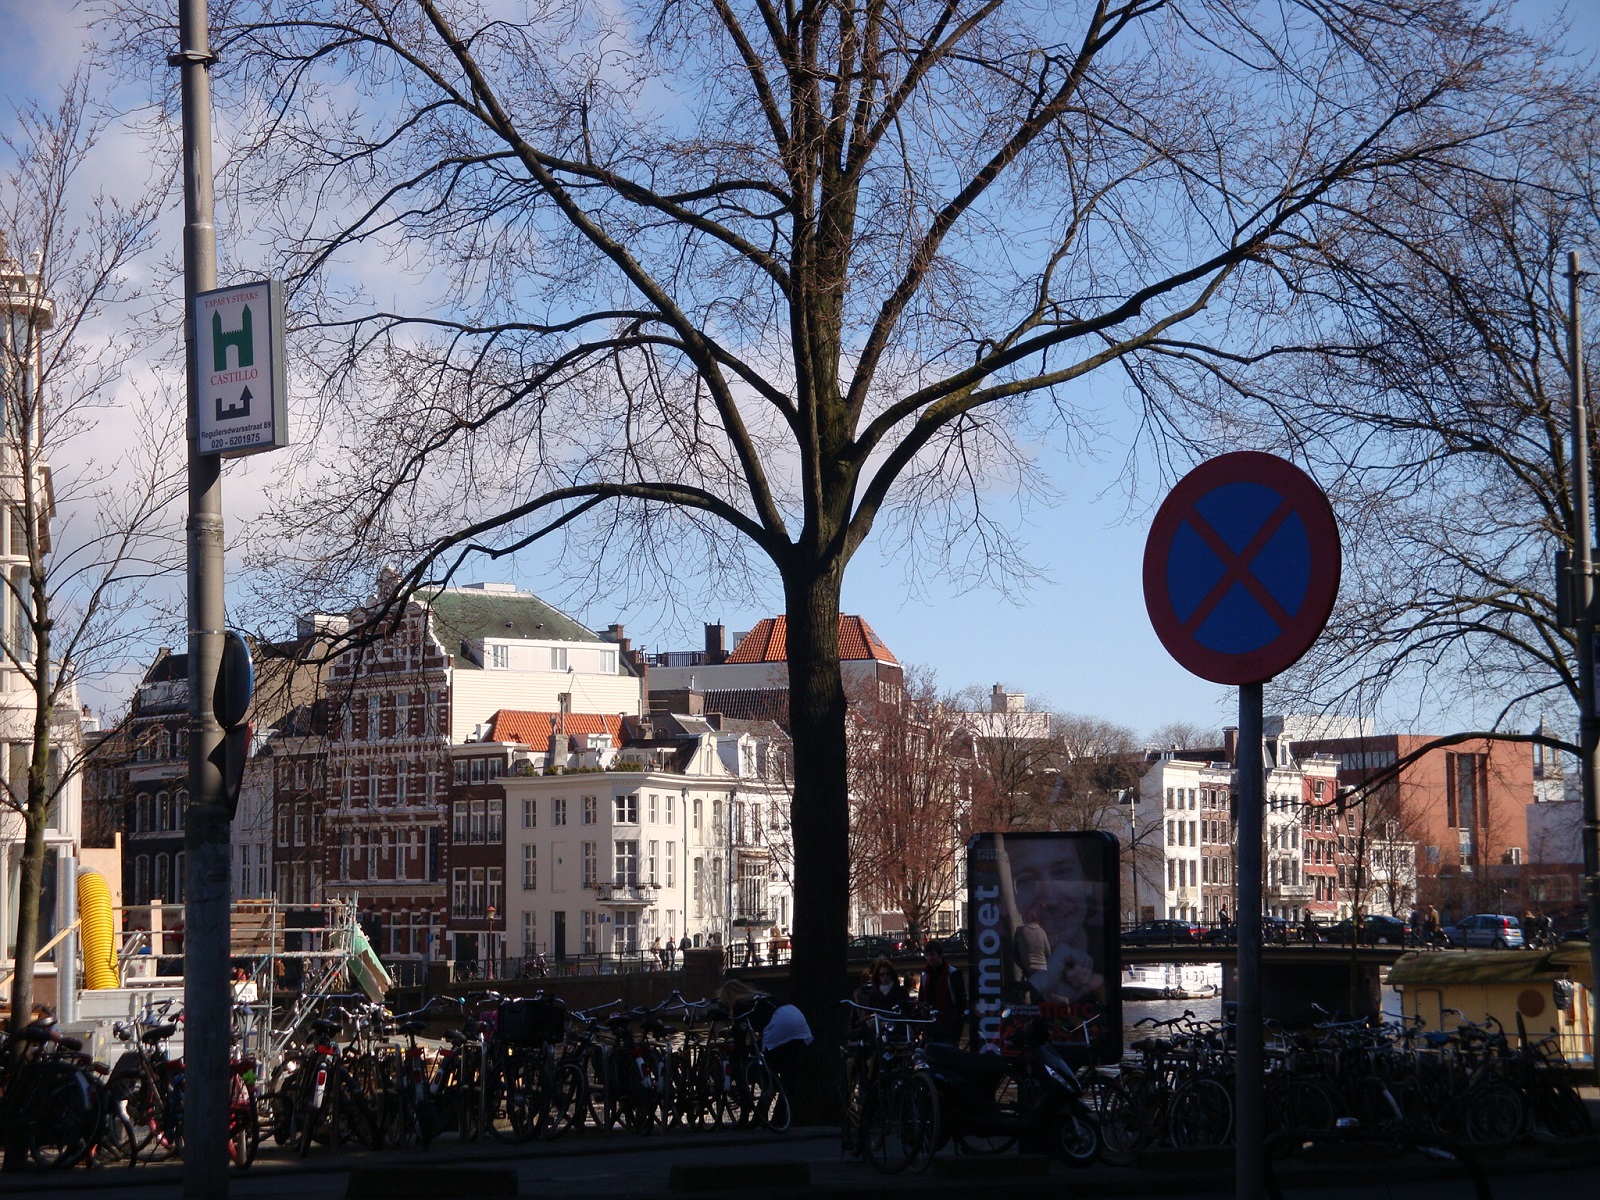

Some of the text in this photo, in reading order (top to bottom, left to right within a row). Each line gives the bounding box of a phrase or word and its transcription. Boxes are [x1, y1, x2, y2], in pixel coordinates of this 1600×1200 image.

[204, 291, 259, 308] TAPAS Y STEAKS
[210, 369, 259, 386] CASTILLO
[201, 421, 271, 439] Reguliersdwarsstraat 89
[211, 438, 223, 449] 020
[229, 433, 260, 446] 6201975
